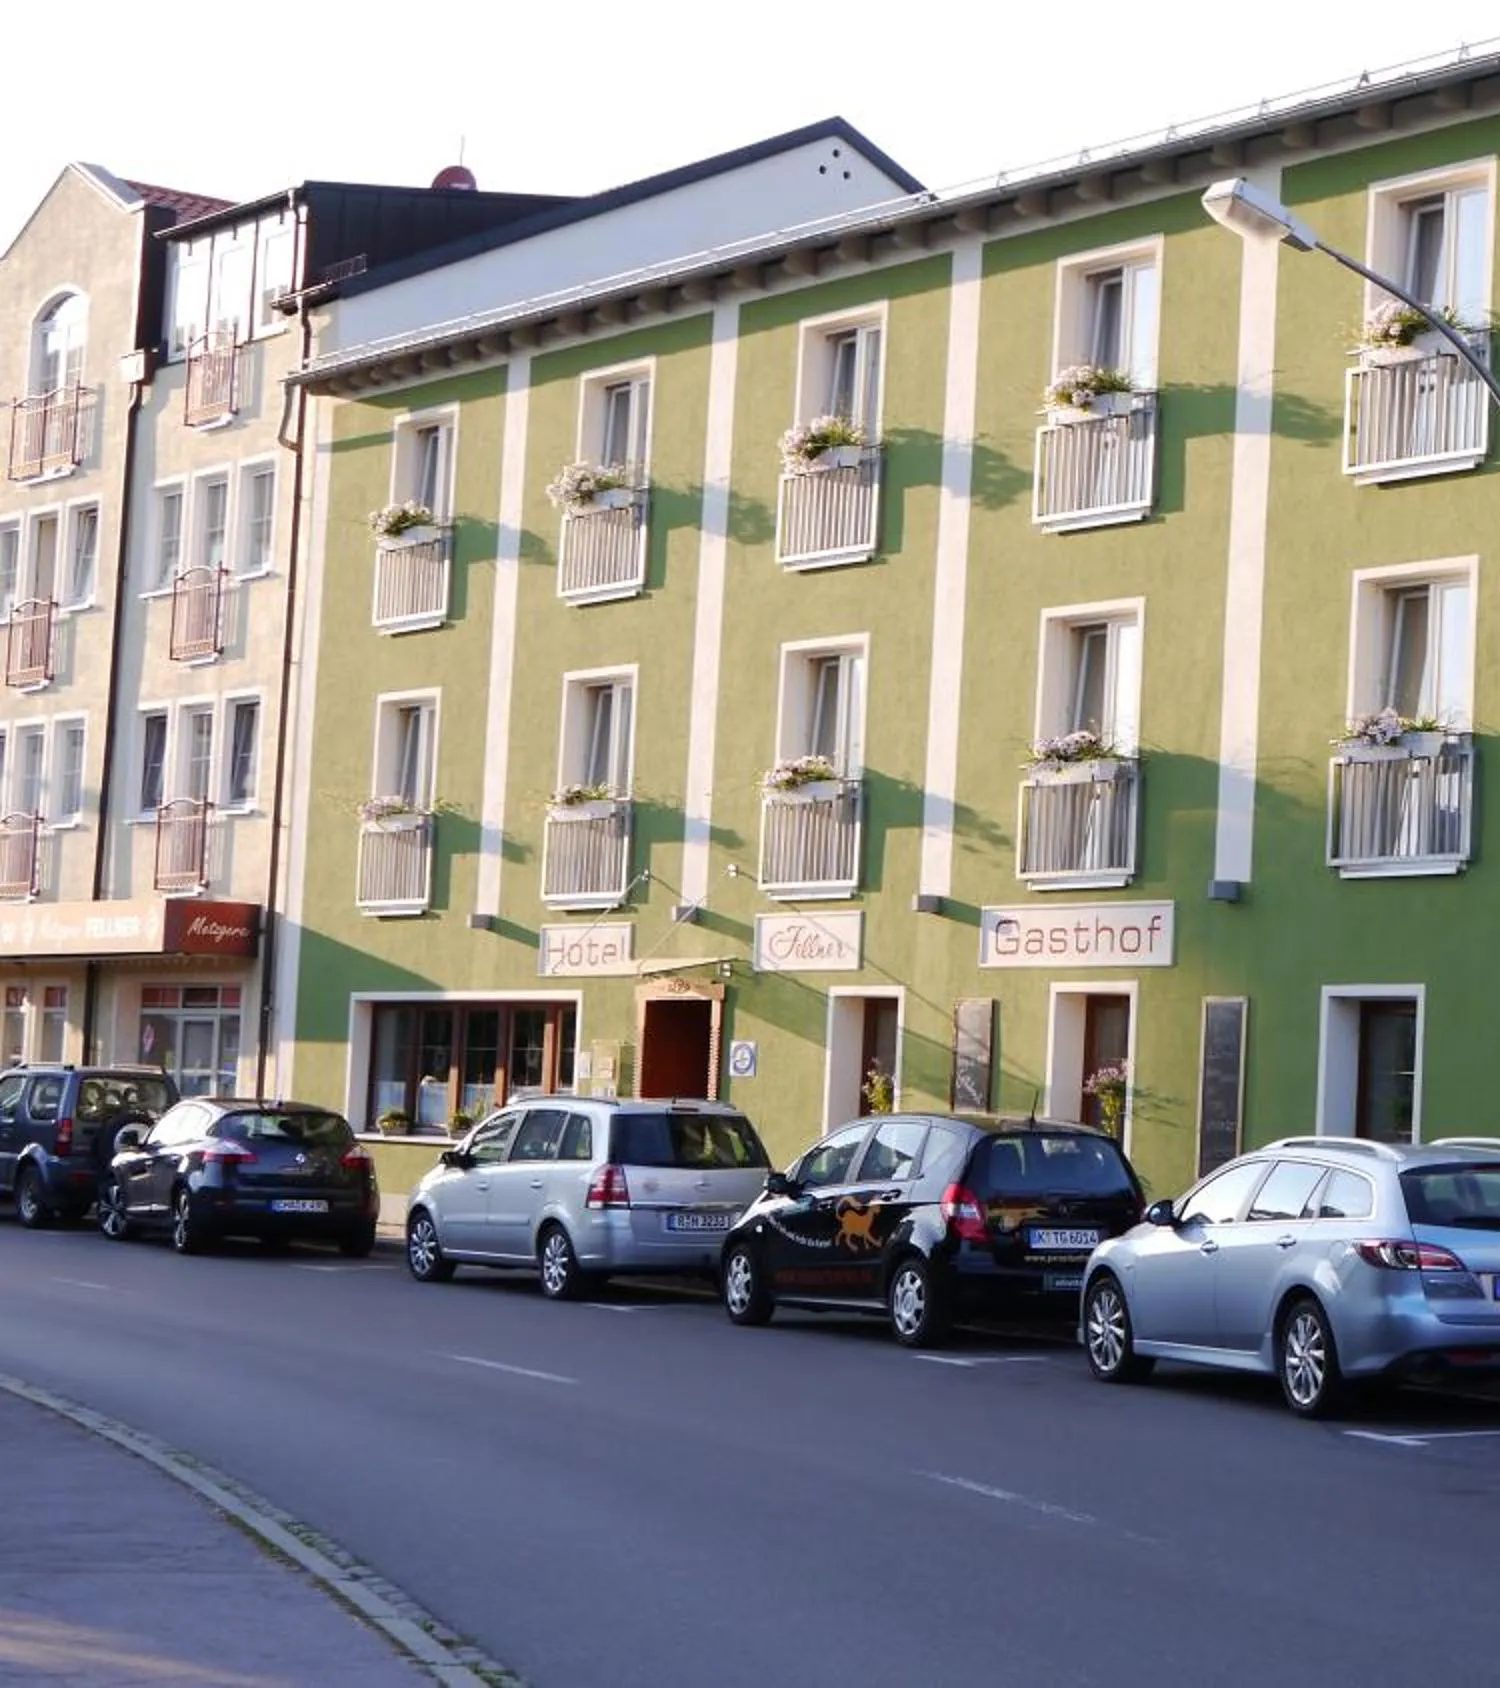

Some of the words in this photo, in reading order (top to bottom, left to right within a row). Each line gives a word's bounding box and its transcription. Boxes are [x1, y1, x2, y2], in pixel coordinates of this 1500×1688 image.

[549, 934, 626, 967] Hotel
[768, 924, 848, 960] Fellner
[994, 915, 1163, 955] Gasthof
